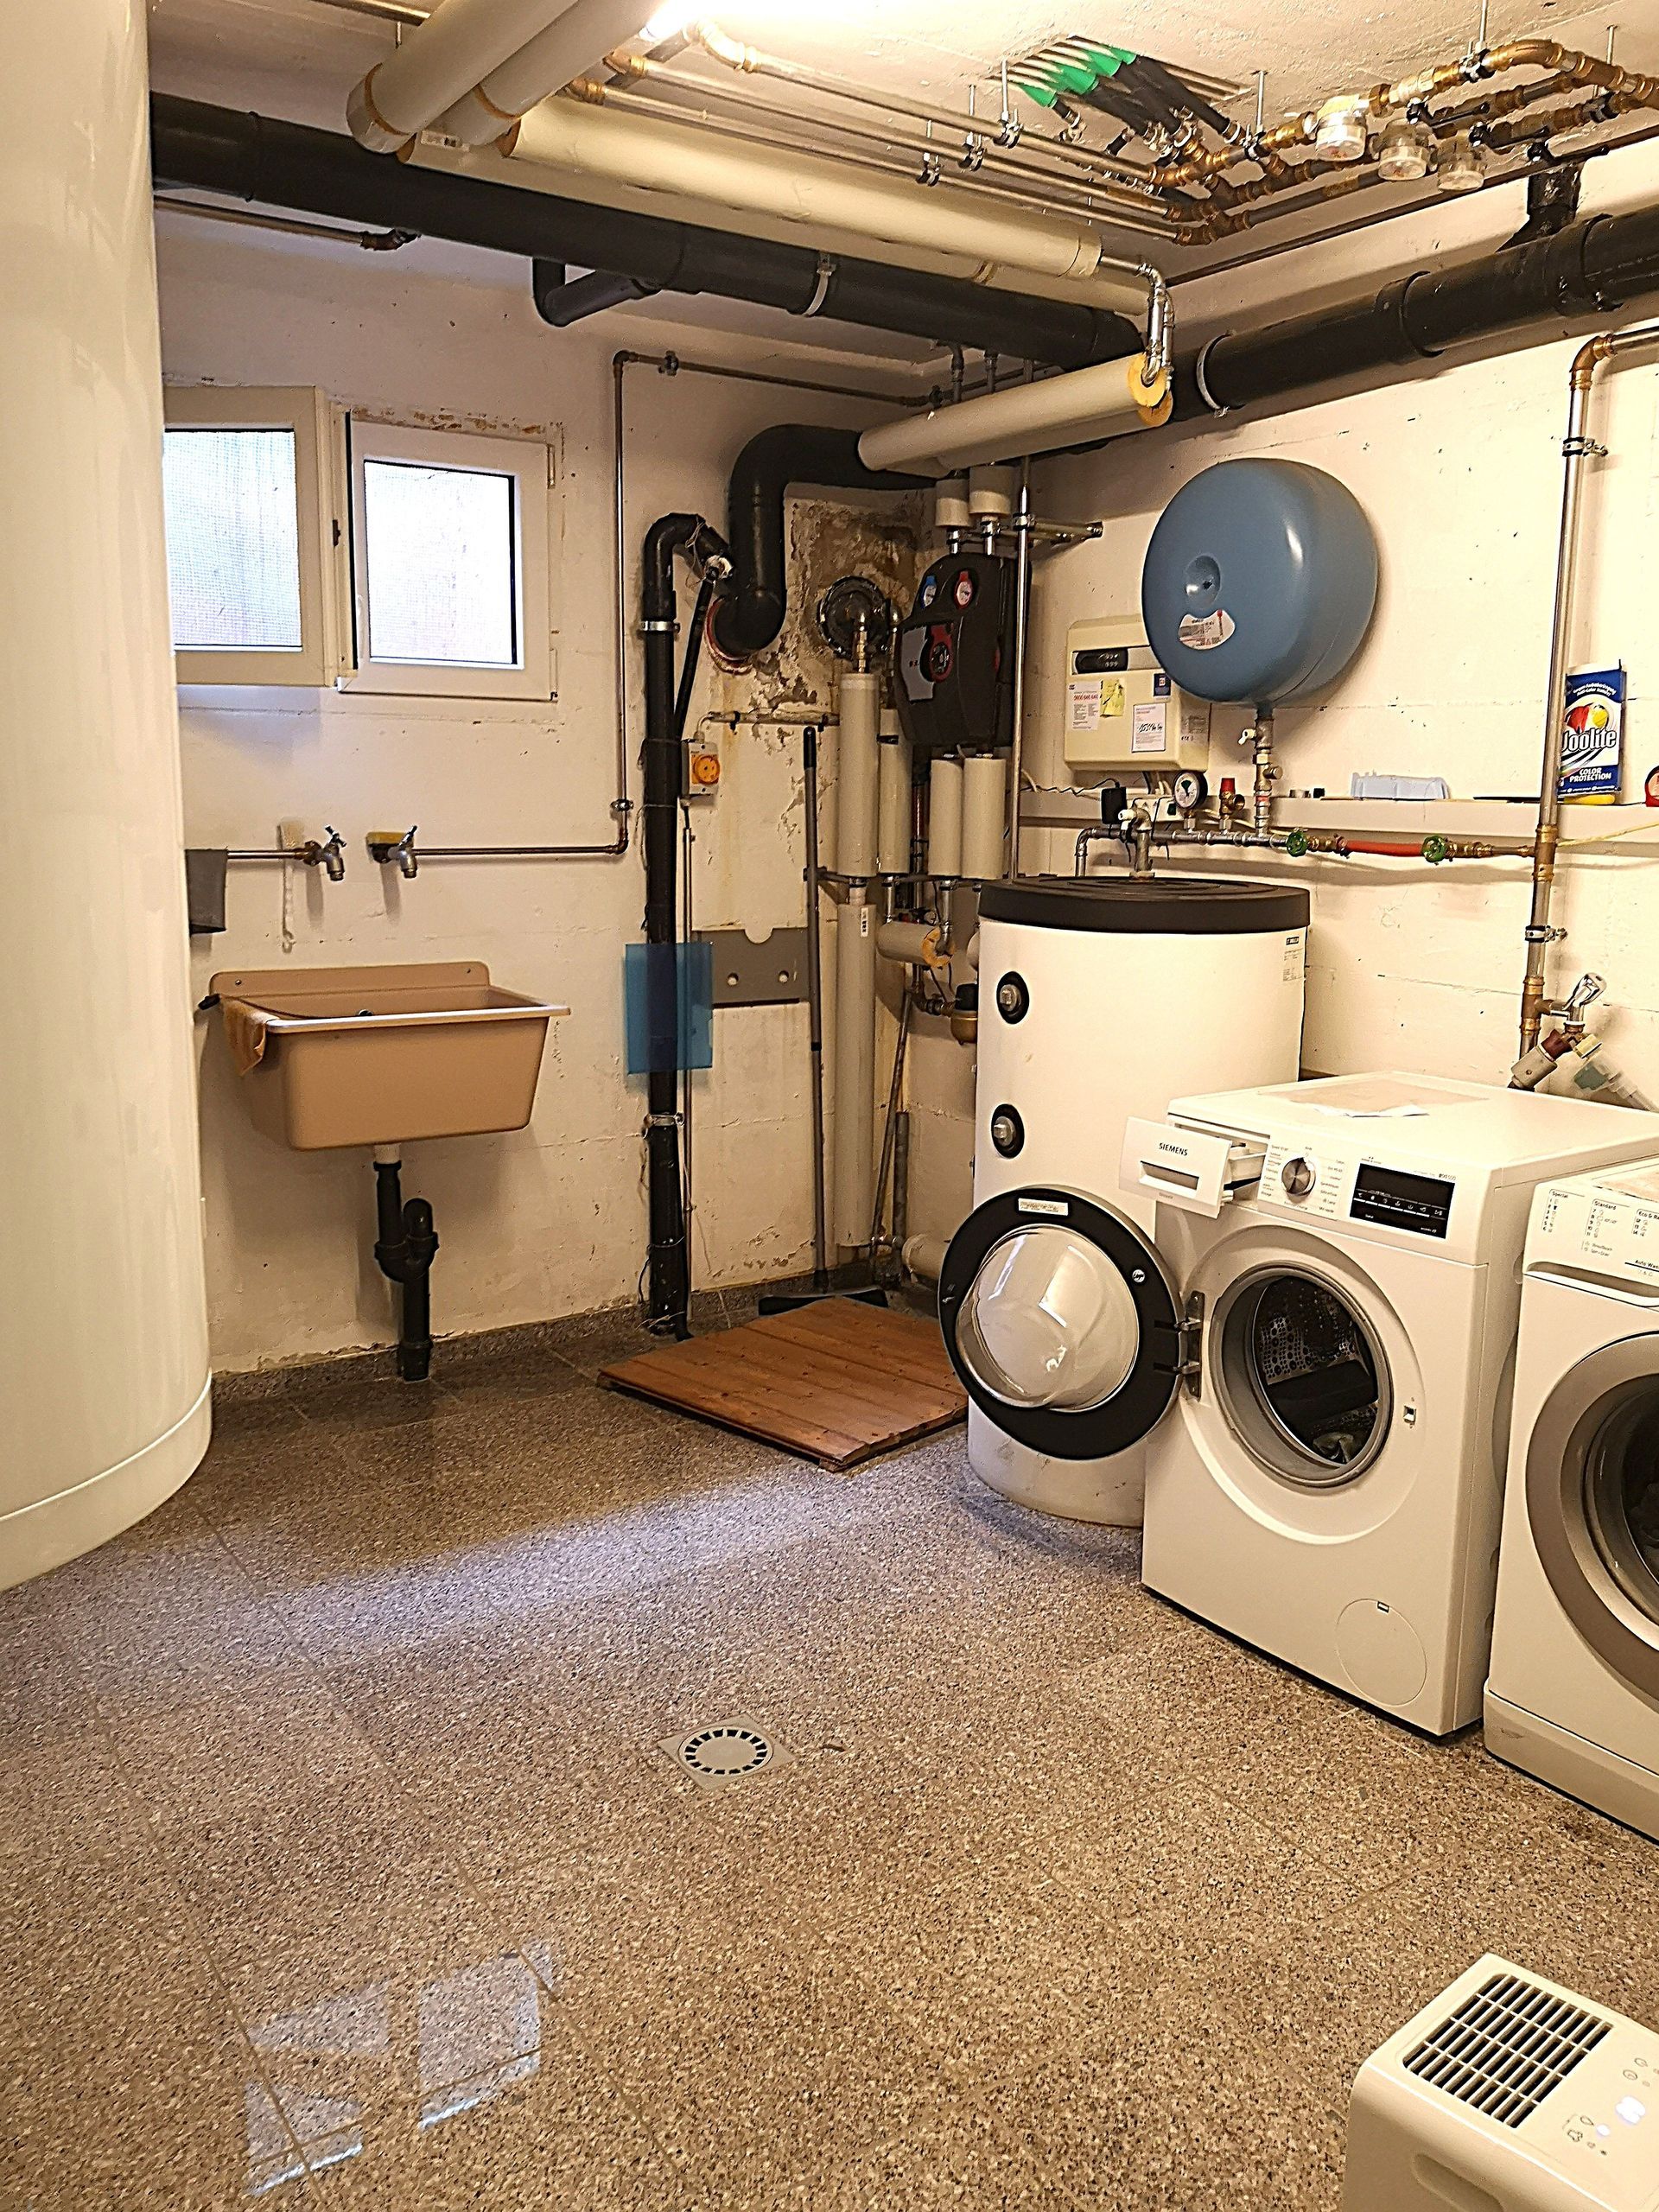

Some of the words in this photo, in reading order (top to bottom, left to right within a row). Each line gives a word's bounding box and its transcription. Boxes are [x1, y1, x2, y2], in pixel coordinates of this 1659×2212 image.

[1580, 767, 1602, 776] COLOR
[1569, 772, 1612, 783] PROTECTION
[1159, 1142, 1188, 1156] SIEMENS
[1594, 1200, 1617, 1210] Standard
